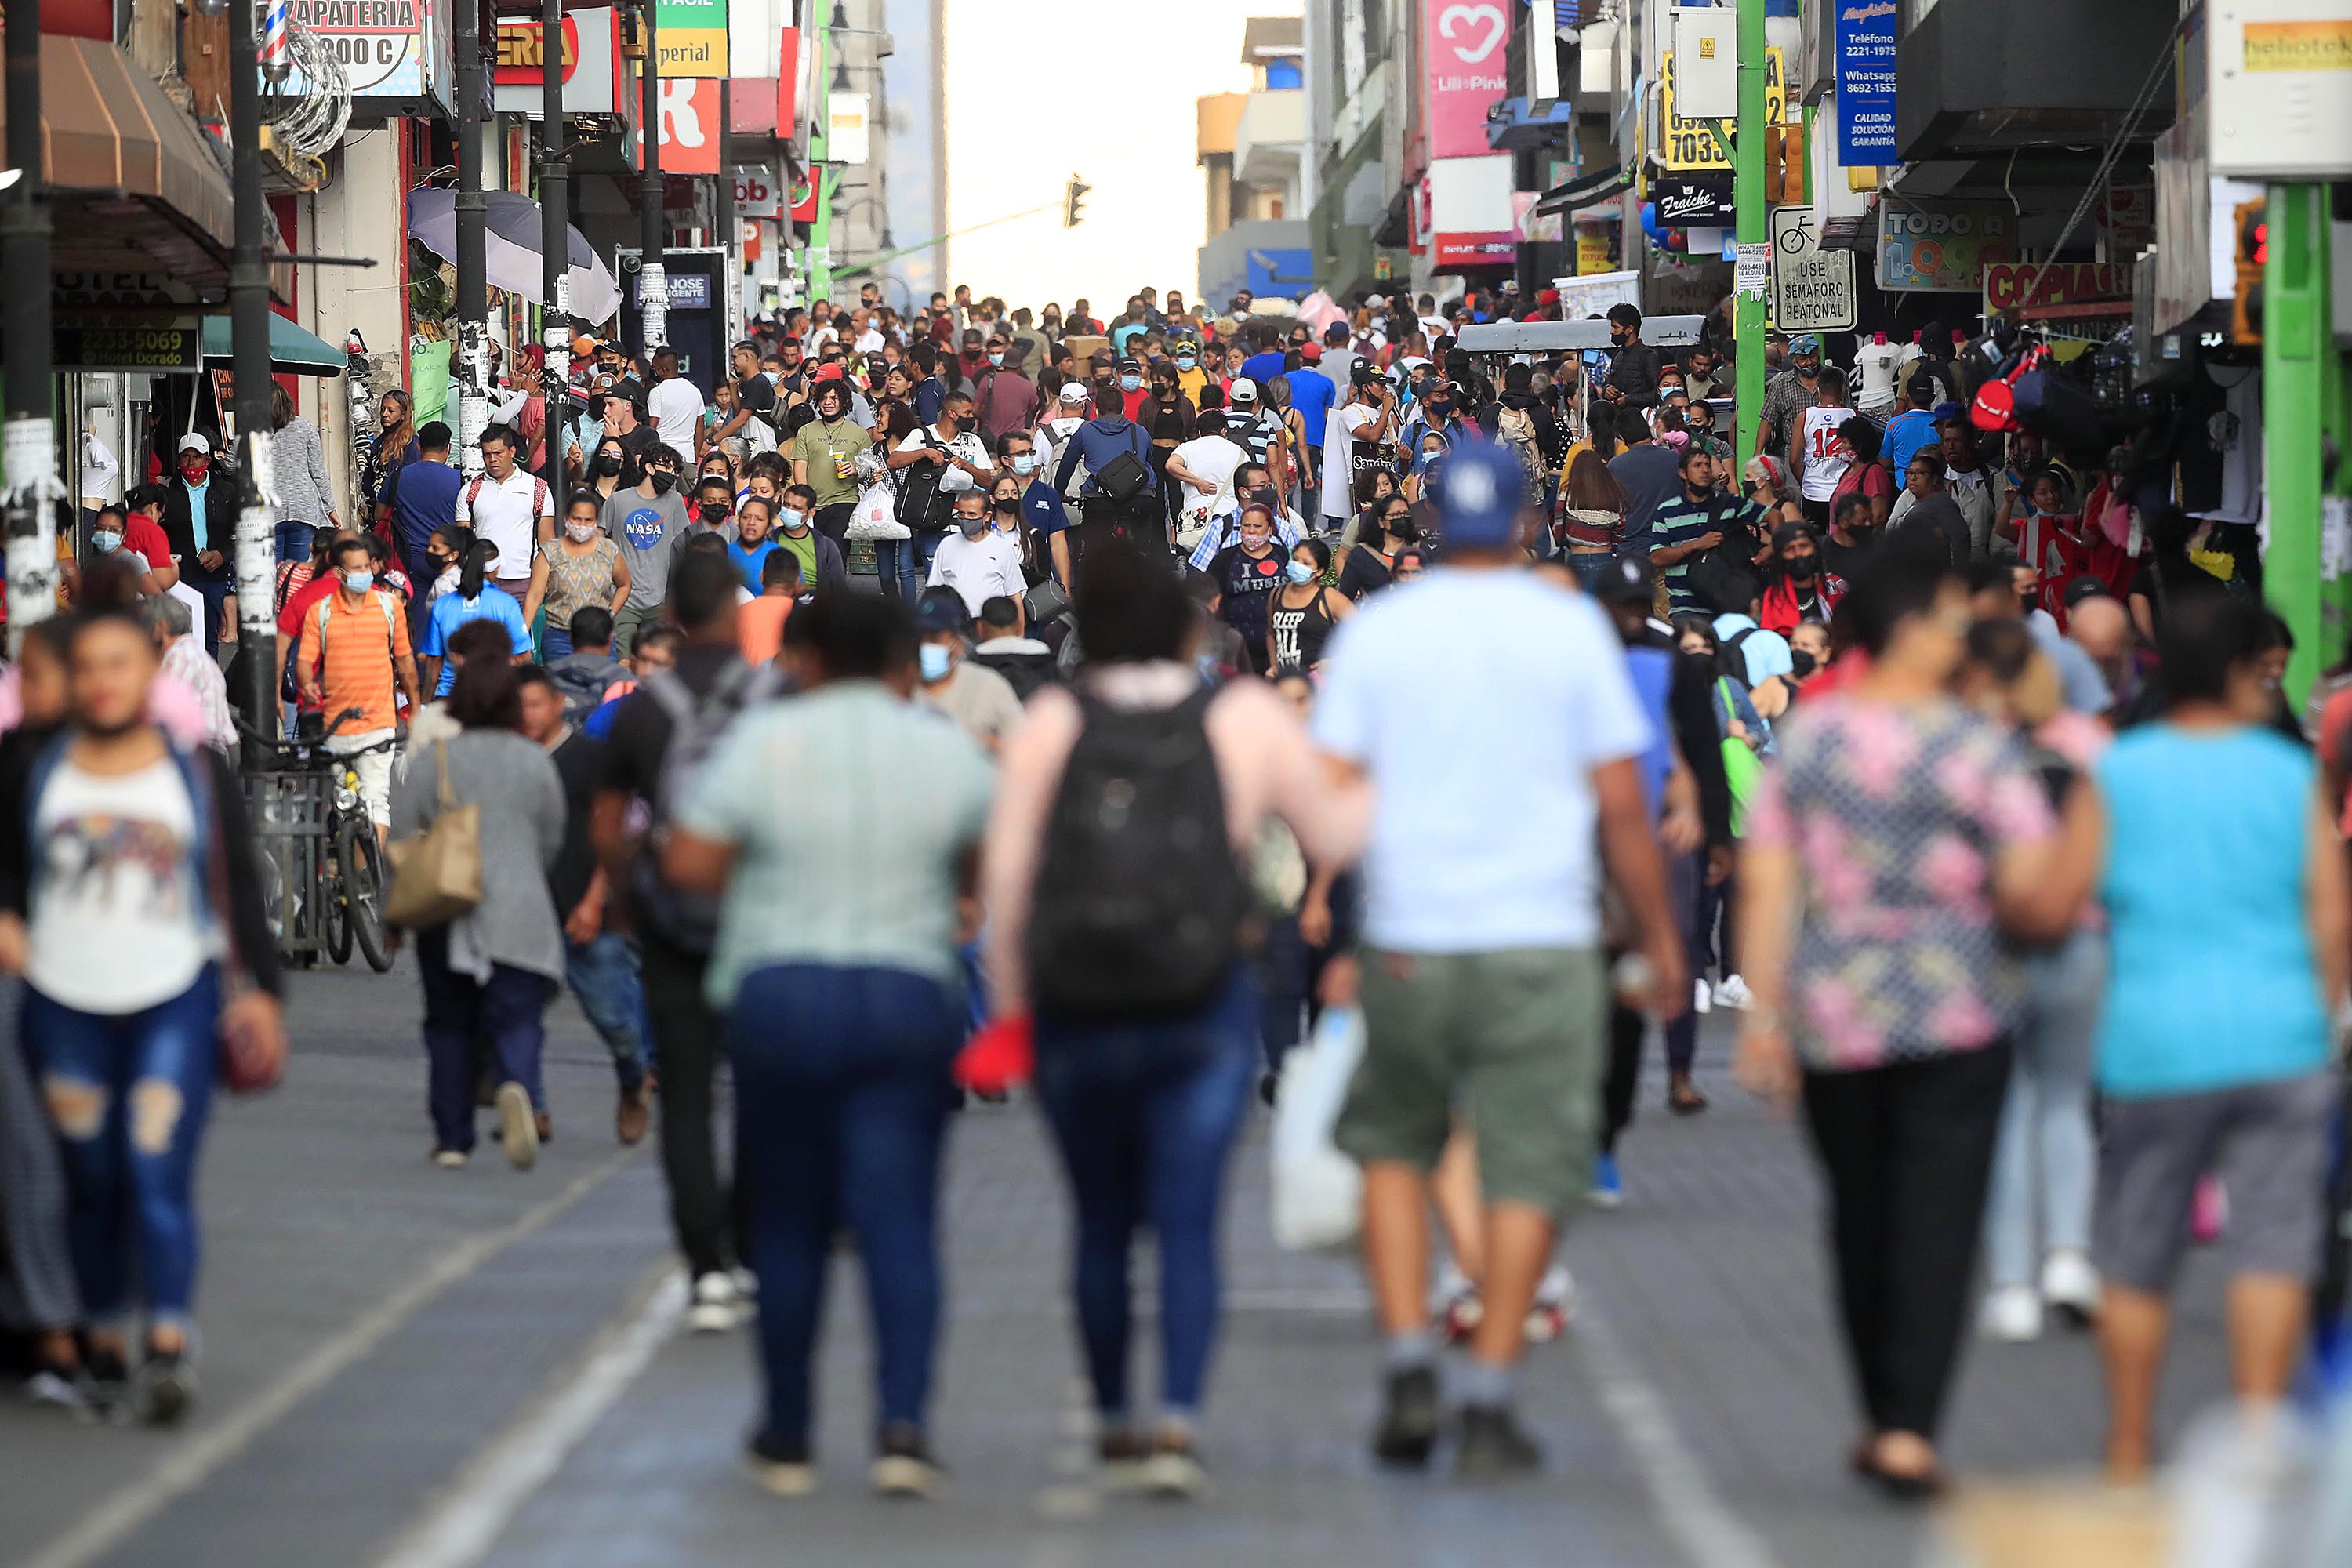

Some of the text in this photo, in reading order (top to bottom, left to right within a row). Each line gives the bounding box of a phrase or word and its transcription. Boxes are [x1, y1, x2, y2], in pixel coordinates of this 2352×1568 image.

[1849, 34, 1894, 43] Teléfono
[660, 42, 709, 67] perial
[1846, 46, 1896, 56] 2221-1975
[1854, 114, 1892, 122] CALIDAD
[1851, 123, 1896, 135] SOLUCIÓN
[1851, 135, 1896, 147] GARANTÍA
[1888, 212, 1973, 234] TODO
[1800, 262, 1826, 277] USE
[1785, 281, 1843, 299] SEMAFORO
[1787, 303, 1844, 320] PEATONAL
[136, 352, 182, 365] Dorado
[1813, 428, 1842, 458] 12
[626, 524, 662, 535] NASA
[1241, 563, 1251, 579] I
[1272, 612, 1305, 629] SLEEP
